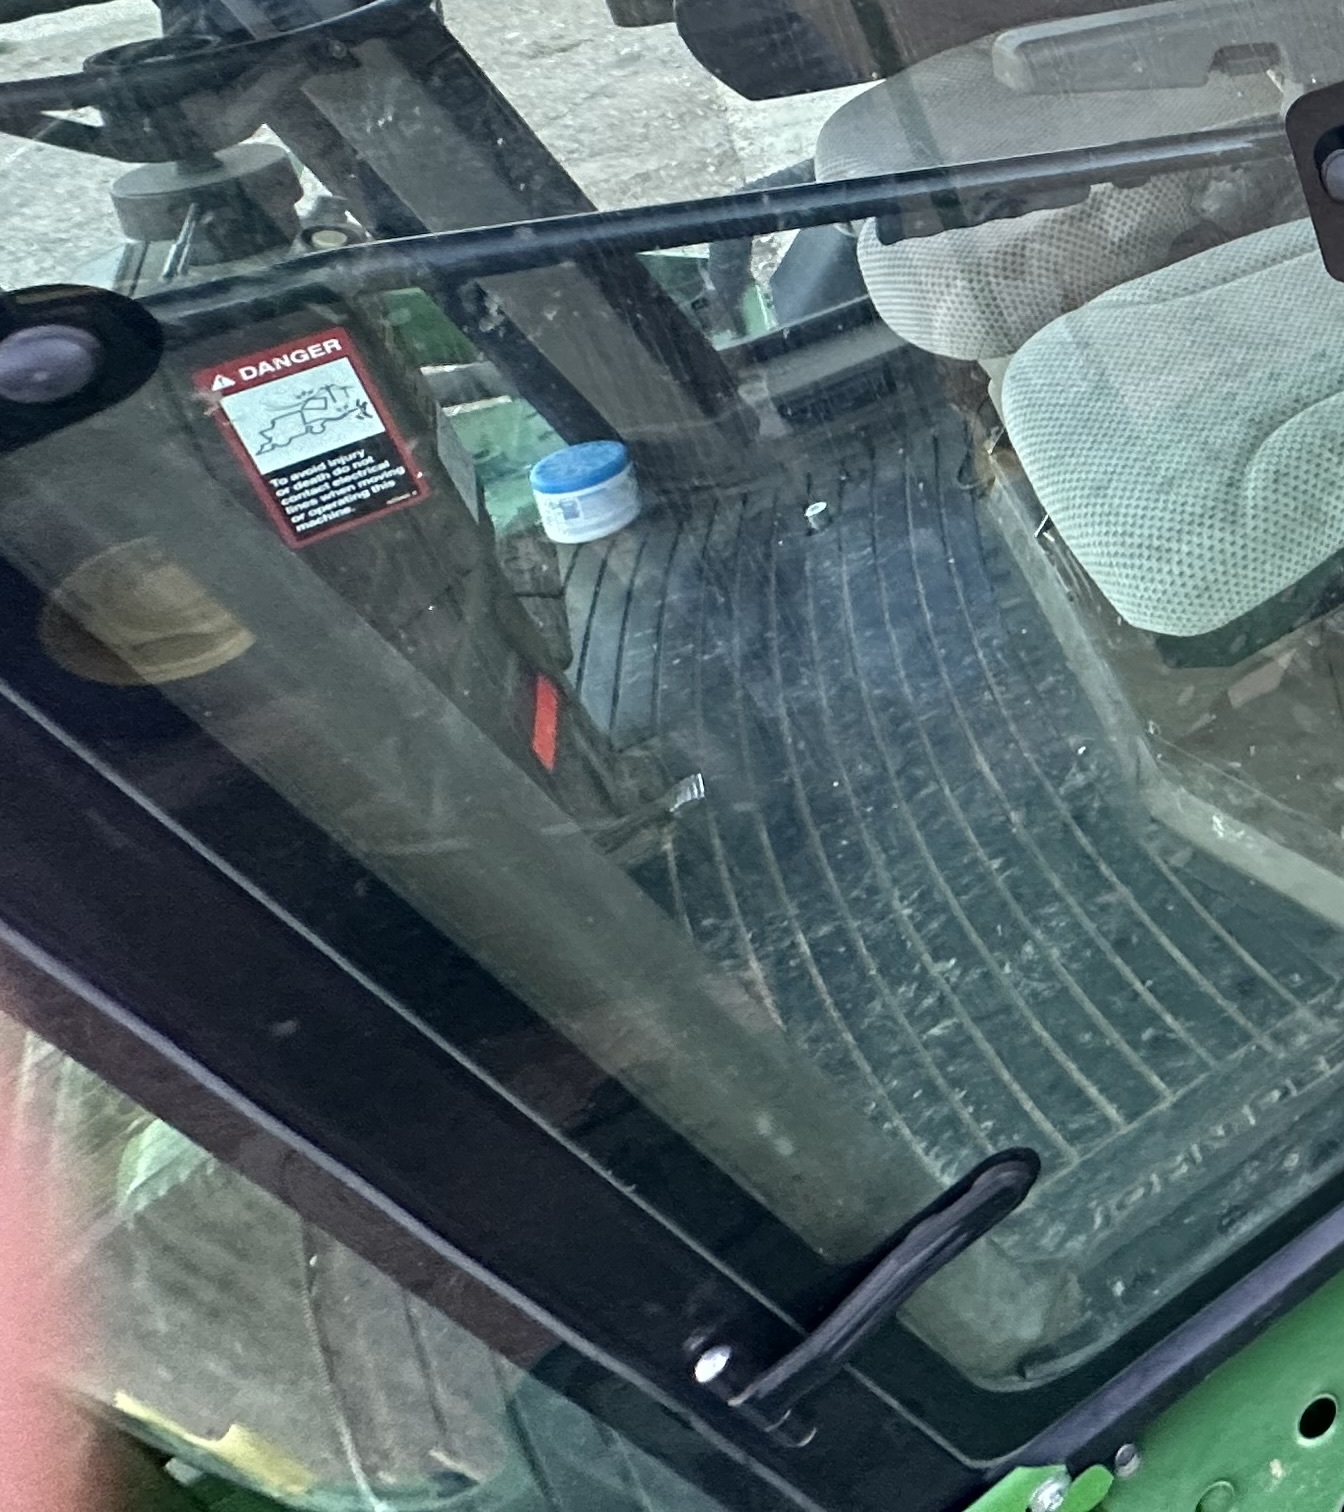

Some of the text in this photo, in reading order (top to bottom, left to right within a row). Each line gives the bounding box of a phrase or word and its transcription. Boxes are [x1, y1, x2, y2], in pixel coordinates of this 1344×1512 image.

[239, 339, 342, 381] DANGER
[269, 449, 365, 488] To avoid injury
[276, 455, 375, 497] or death do not
[281, 460, 390, 506] contact electrical
[285, 466, 406, 515] lines when moving
[290, 512, 305, 524] or
[308, 489, 371, 517] operating
[371, 480, 396, 493] this
